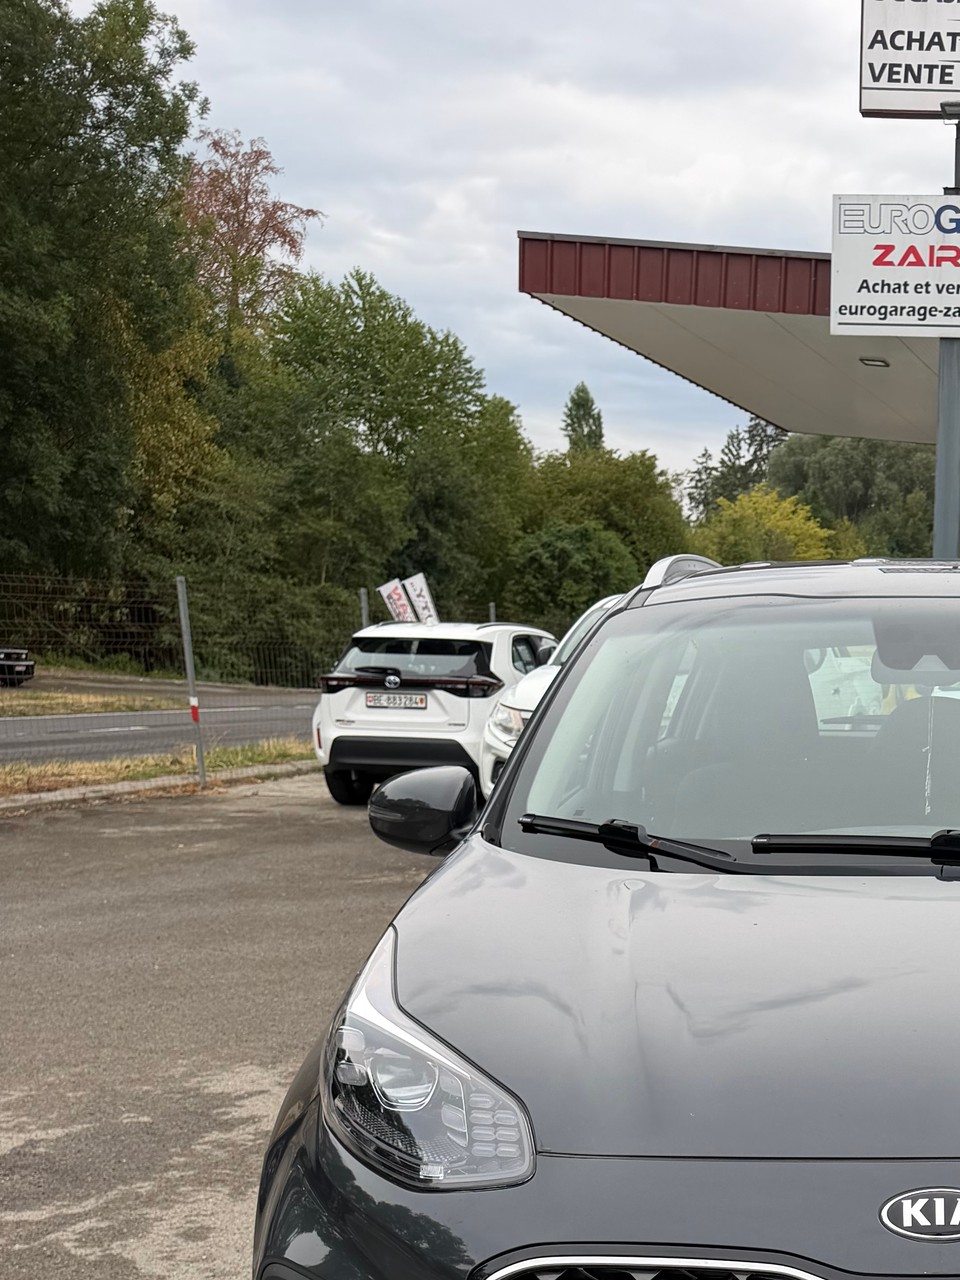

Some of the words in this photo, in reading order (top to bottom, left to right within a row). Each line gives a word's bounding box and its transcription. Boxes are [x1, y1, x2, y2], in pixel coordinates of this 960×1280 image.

[867, 62, 955, 85] VENTE
[857, 278, 909, 294] Achat
[914, 281, 931, 295] et
